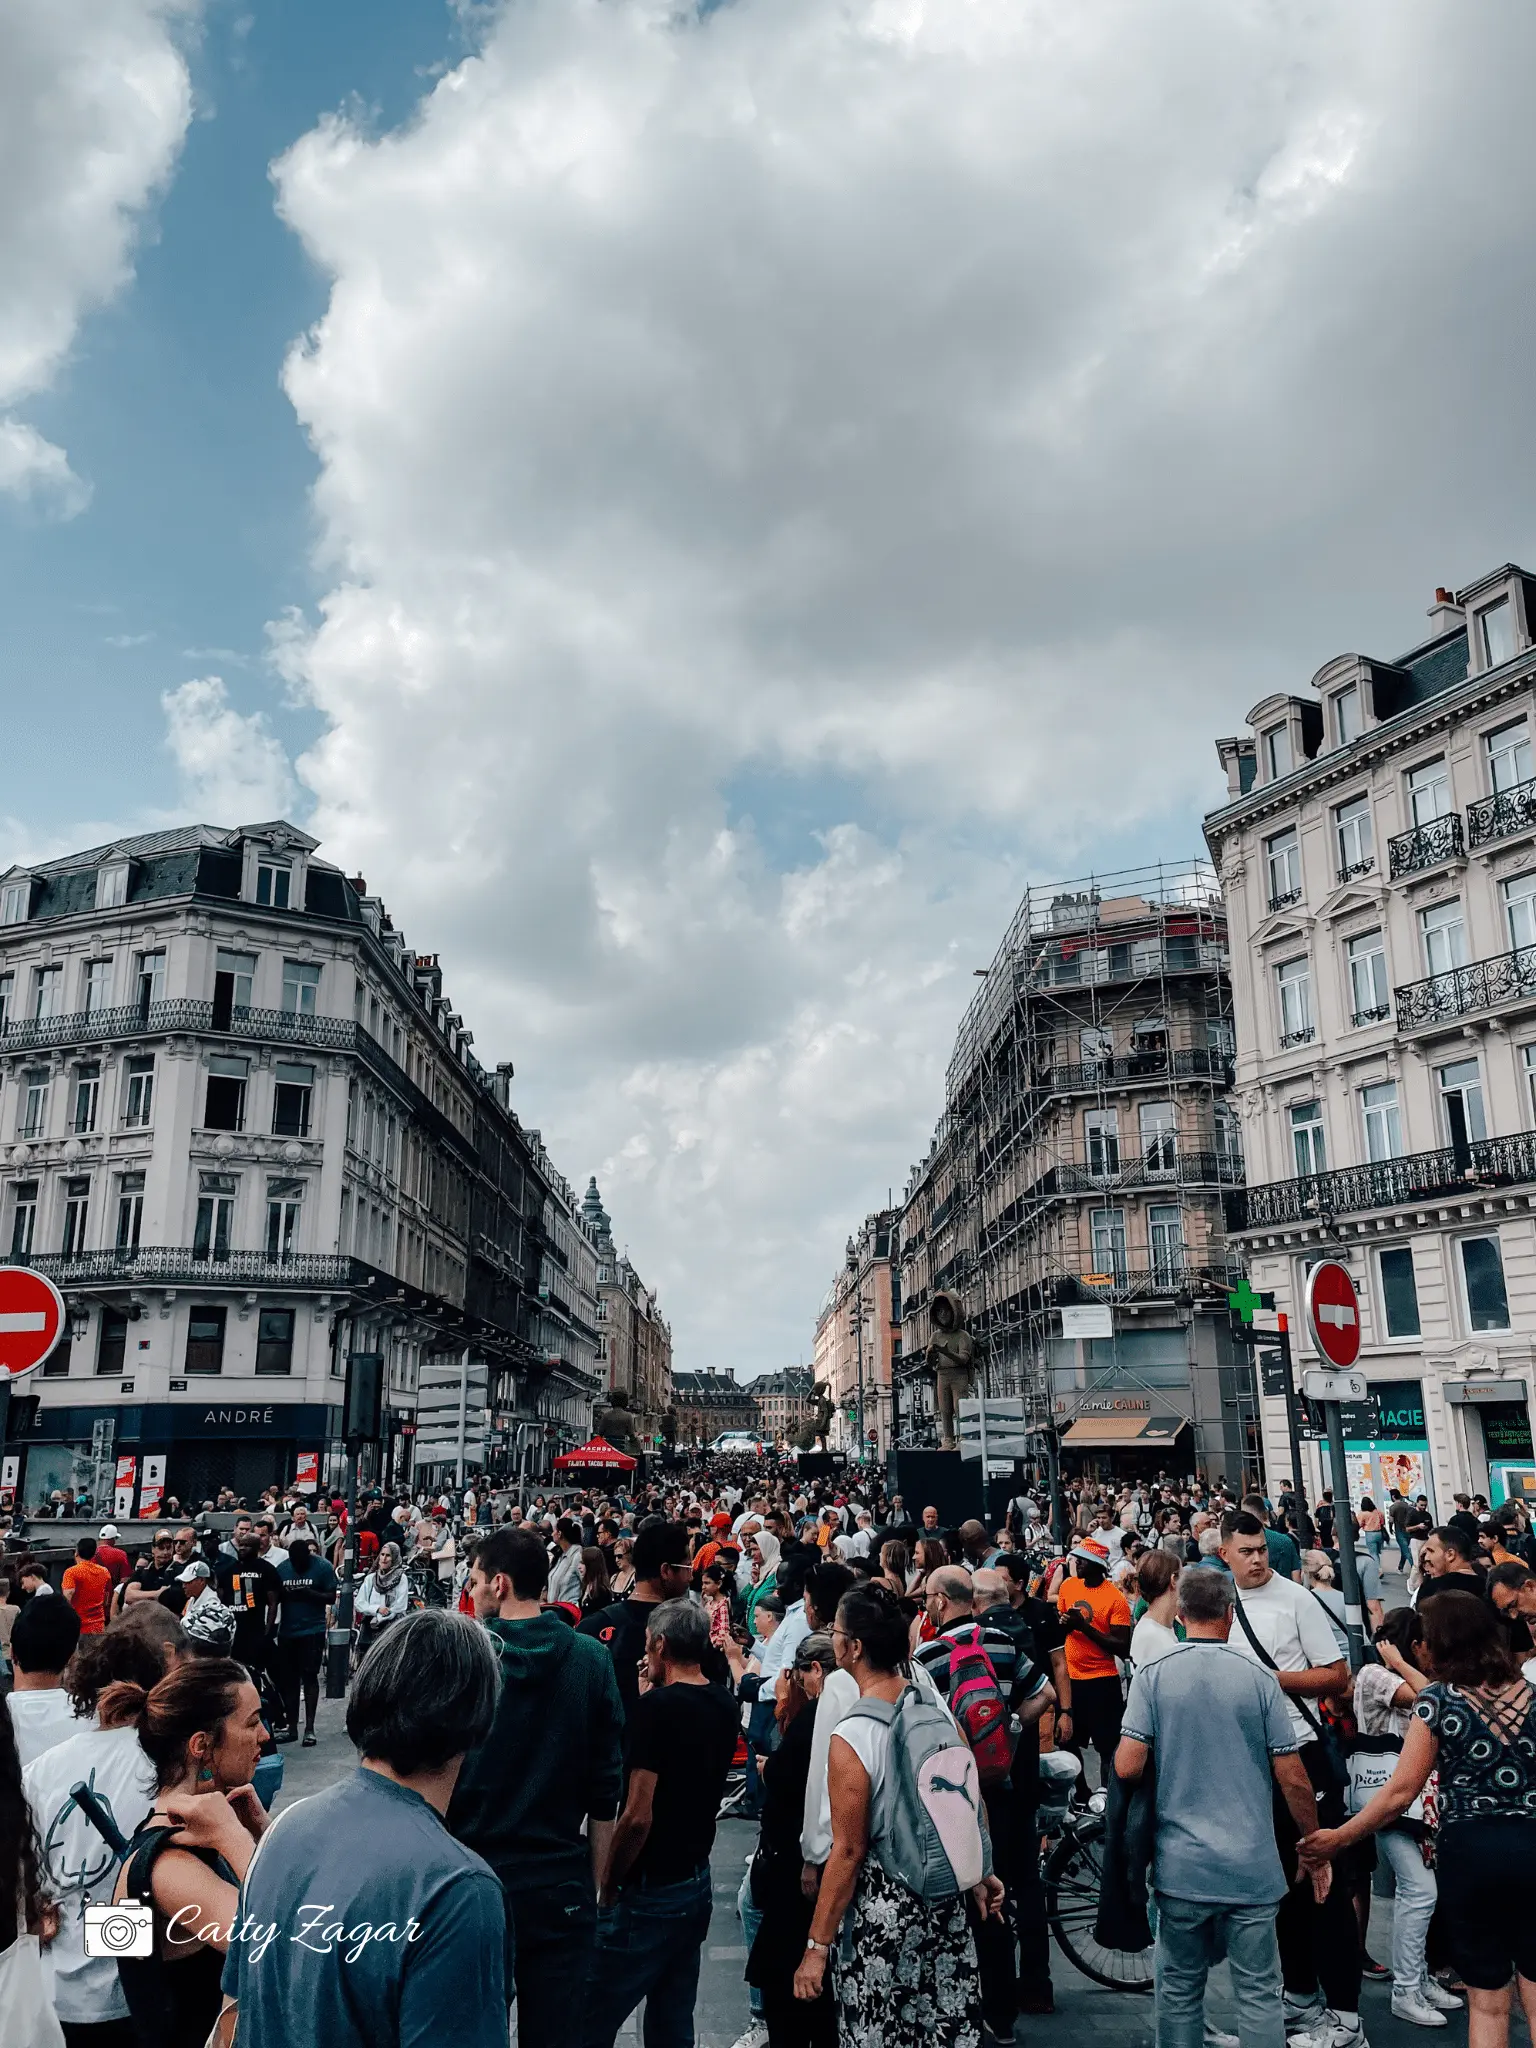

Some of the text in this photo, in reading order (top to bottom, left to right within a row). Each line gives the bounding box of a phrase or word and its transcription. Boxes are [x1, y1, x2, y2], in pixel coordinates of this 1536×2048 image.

[913, 1378, 921, 1415] HOTEL
[1080, 1398, 1090, 1411] la
[1092, 1398, 1113, 1410] mie
[1114, 1397, 1150, 1411] CÂLINE
[204, 1406, 273, 1423] ANDRÉ
